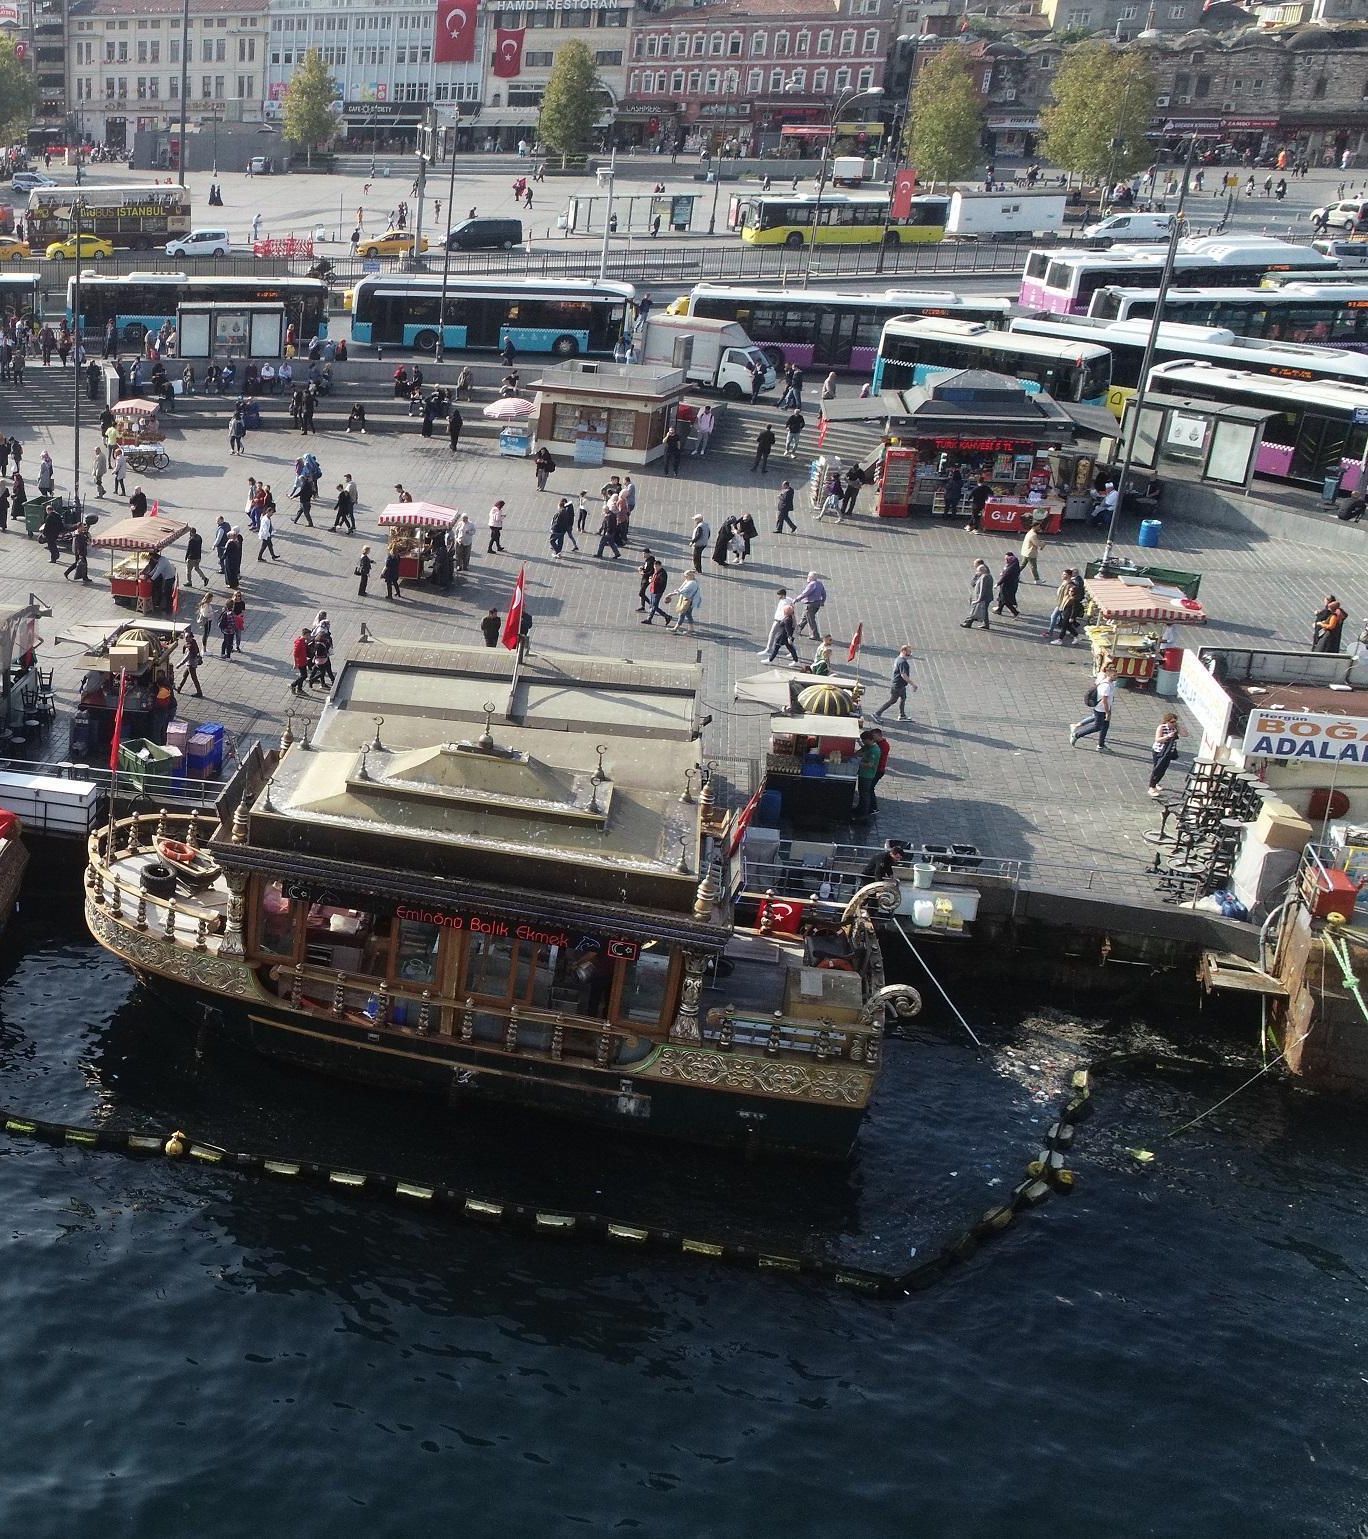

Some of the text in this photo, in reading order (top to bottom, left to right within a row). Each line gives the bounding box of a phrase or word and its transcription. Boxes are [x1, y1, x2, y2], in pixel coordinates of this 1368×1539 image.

[546, 0, 618, 9] RESTORAN
[117, 206, 166, 216] ISTANBUL
[470, 917, 509, 937] Balık
[516, 925, 569, 948] Ekmek
